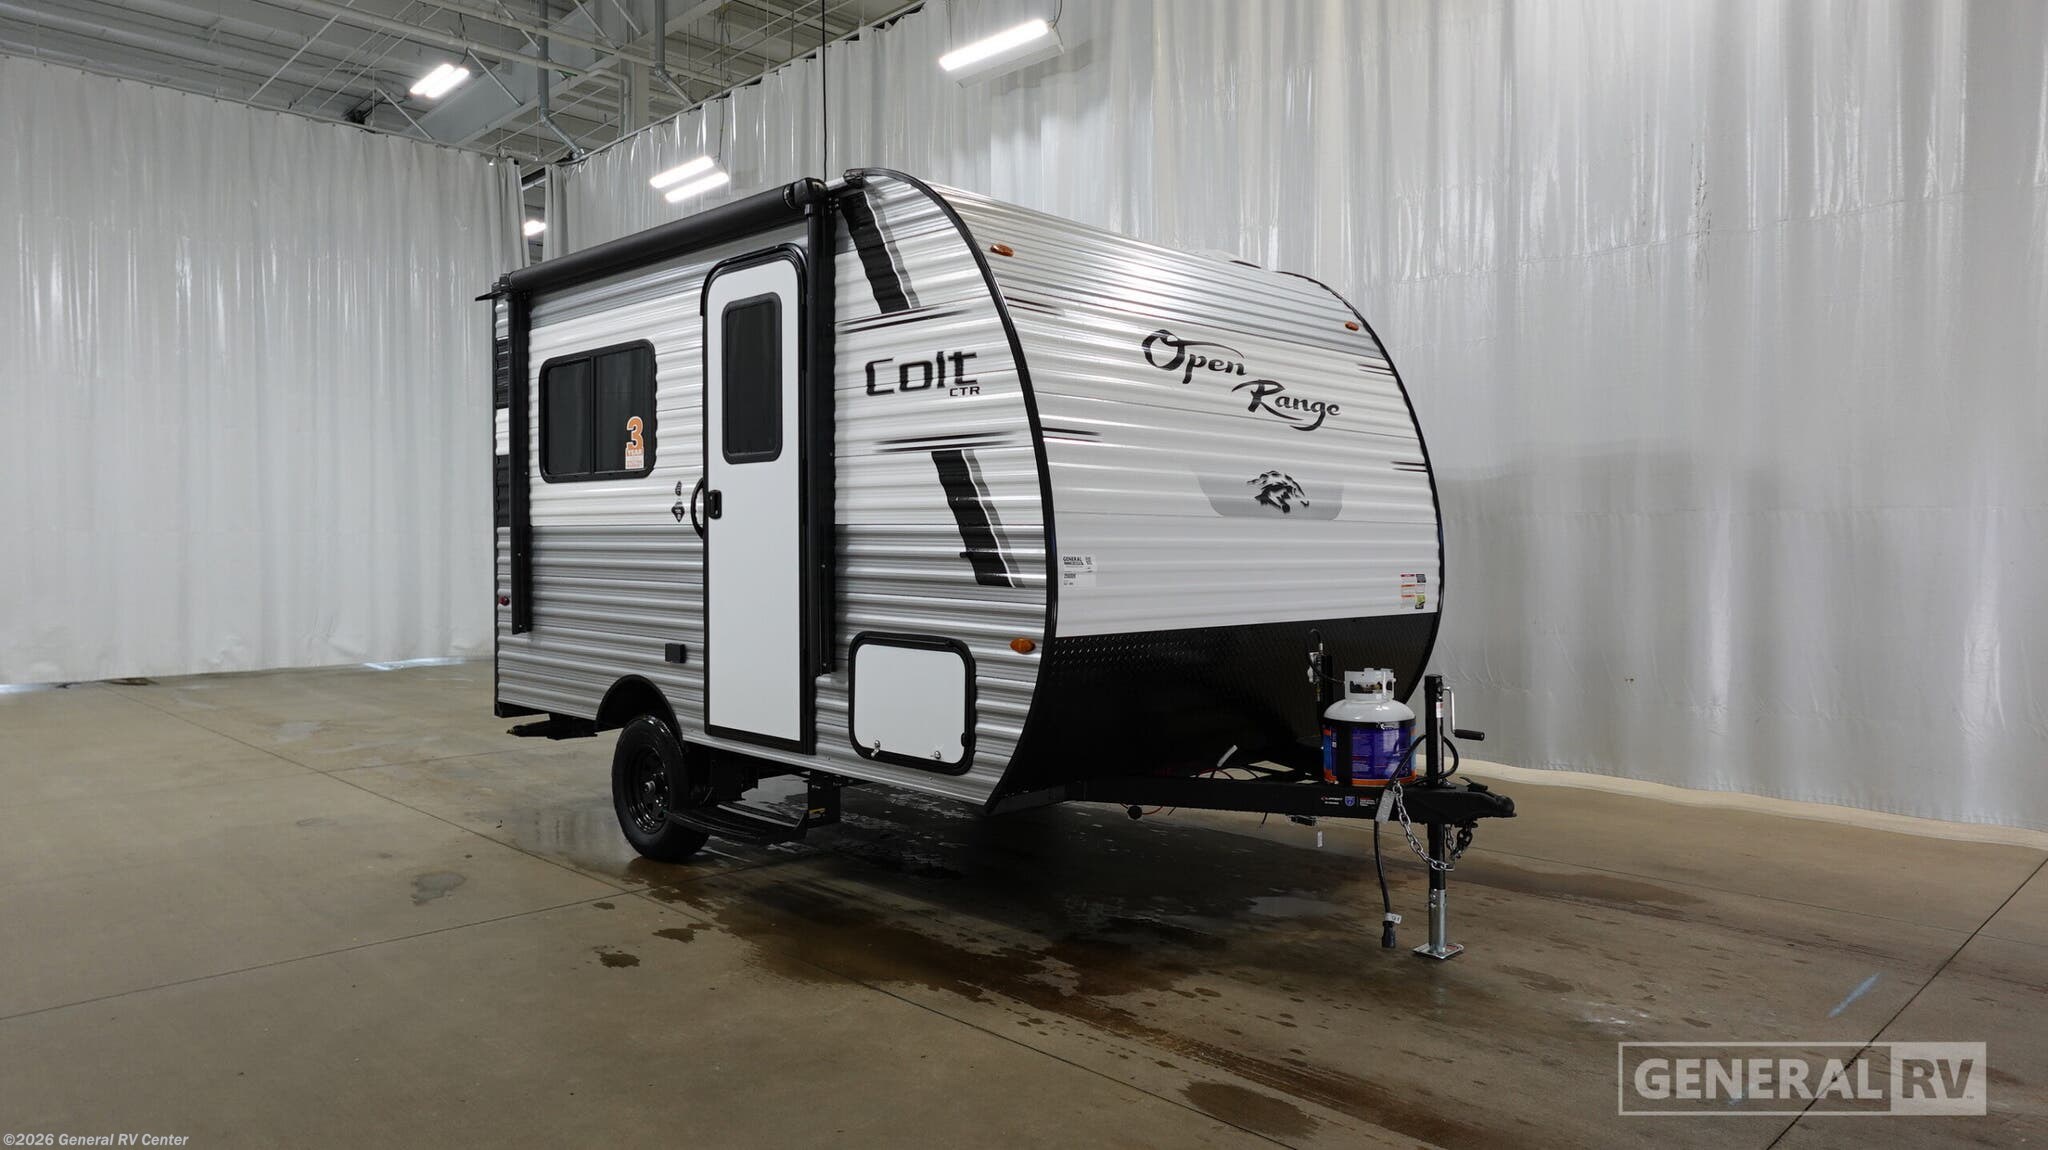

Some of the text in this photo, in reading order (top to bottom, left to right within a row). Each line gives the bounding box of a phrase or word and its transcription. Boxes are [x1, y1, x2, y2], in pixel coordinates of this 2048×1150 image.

[865, 350, 978, 397] Colt
[1141, 329, 1248, 385] Open
[949, 386, 981, 397] CTR
[1231, 379, 1341, 431] Range
[626, 416, 644, 450] 3
